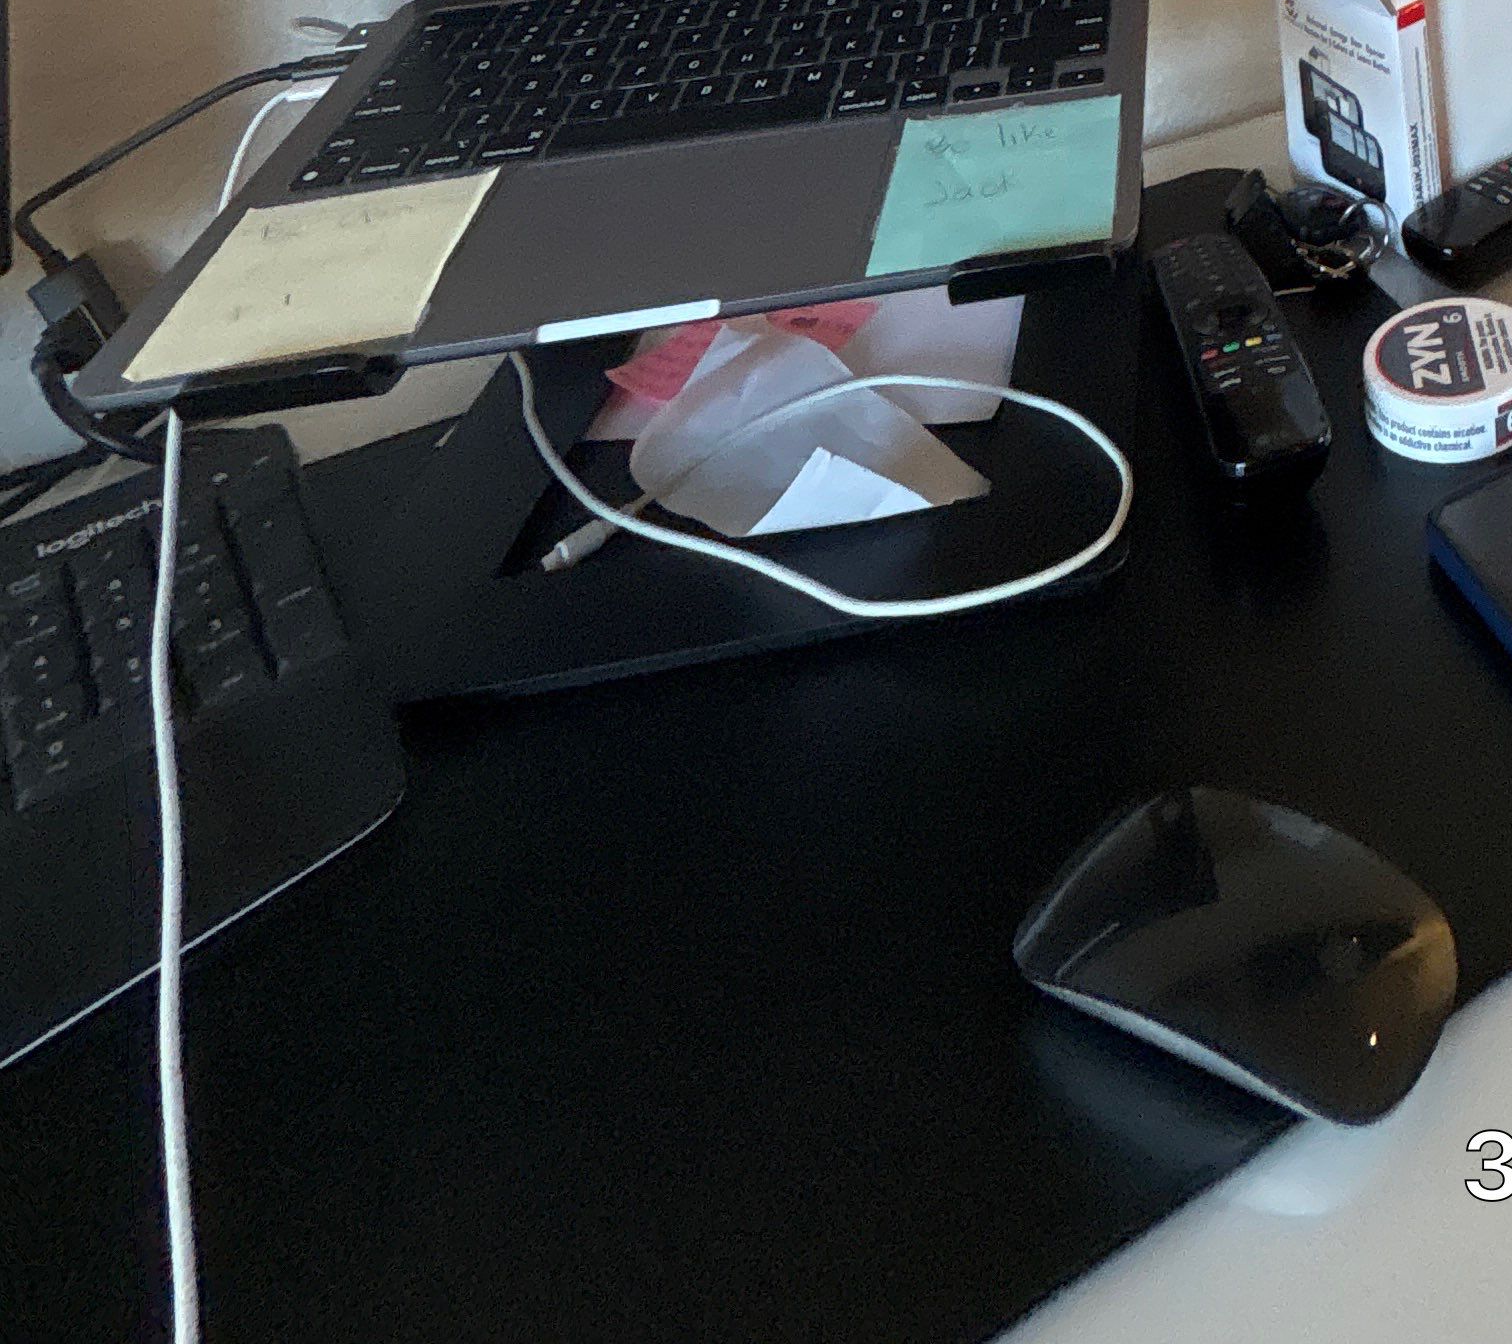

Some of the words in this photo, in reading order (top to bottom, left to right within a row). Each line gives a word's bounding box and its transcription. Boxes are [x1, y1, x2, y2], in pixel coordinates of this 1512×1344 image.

[1442, 312, 1463, 324] 6
[1403, 321, 1453, 390] ZYN
[1390, 419, 1416, 436] product
[1418, 426, 1451, 439] contains
[1398, 435, 1432, 451] addictive
[36, 498, 163, 559] logitech
